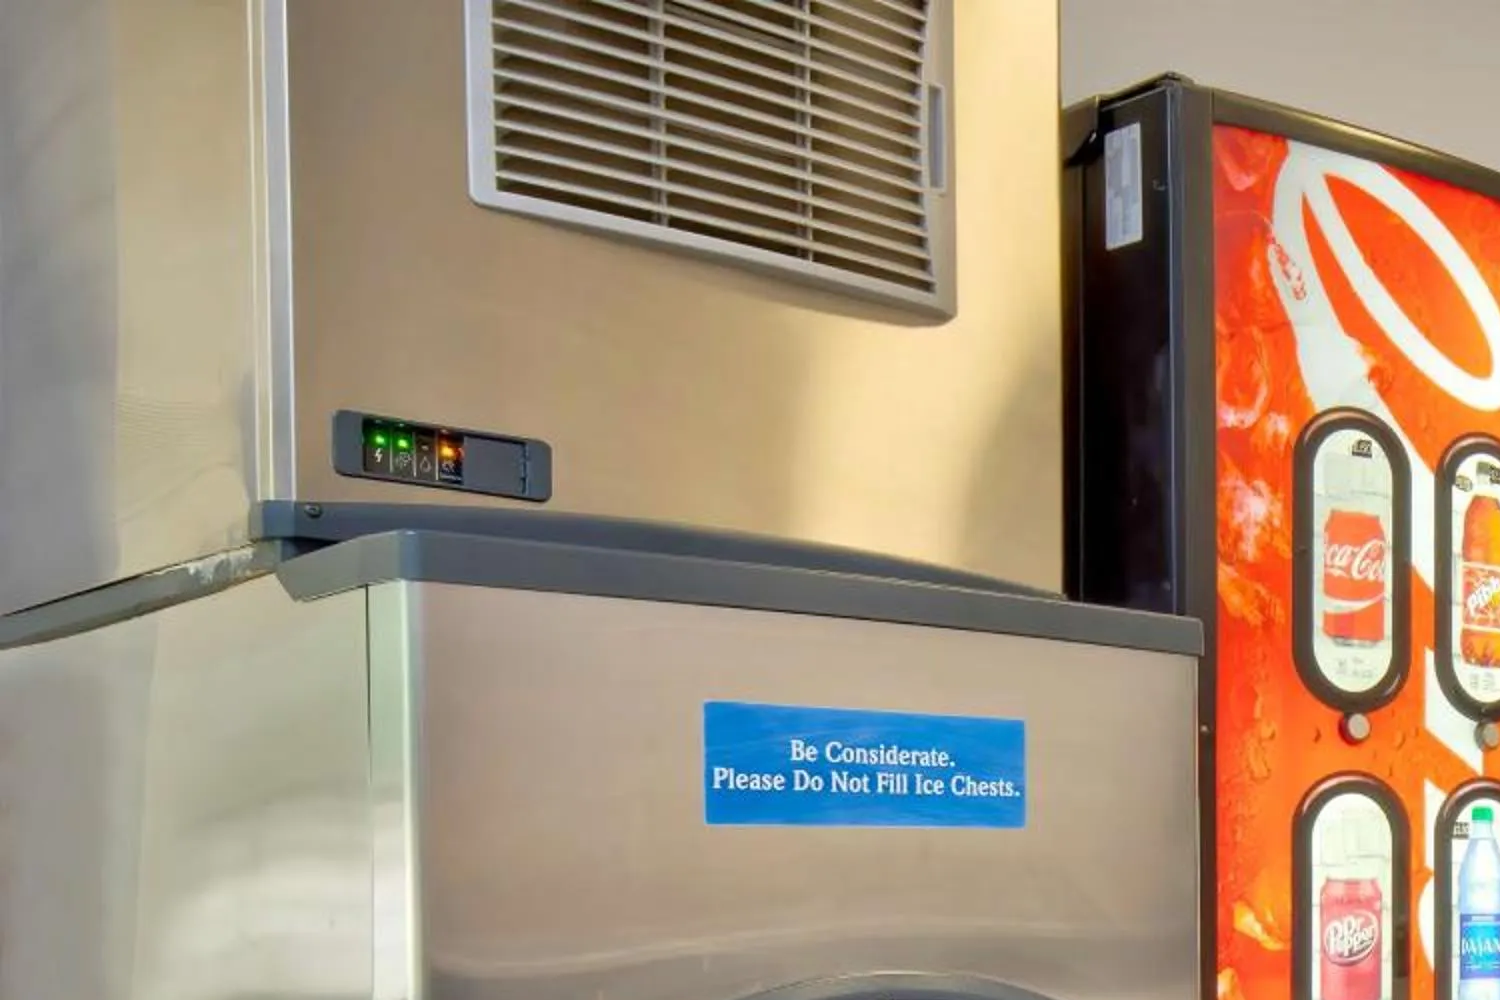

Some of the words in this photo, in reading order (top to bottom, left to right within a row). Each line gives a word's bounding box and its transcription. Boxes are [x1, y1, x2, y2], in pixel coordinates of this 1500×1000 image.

[790, 739, 819, 763] Be
[825, 741, 956, 768] Considerate.
[712, 767, 785, 791] Please
[793, 769, 825, 792] Do
[831, 771, 870, 794] Not
[877, 772, 909, 795] Fill
[915, 774, 945, 796] Ice
[950, 775, 1021, 798] Chests.
[1328, 921, 1374, 957] Pepper
[1343, 915, 1365, 934] Dr
